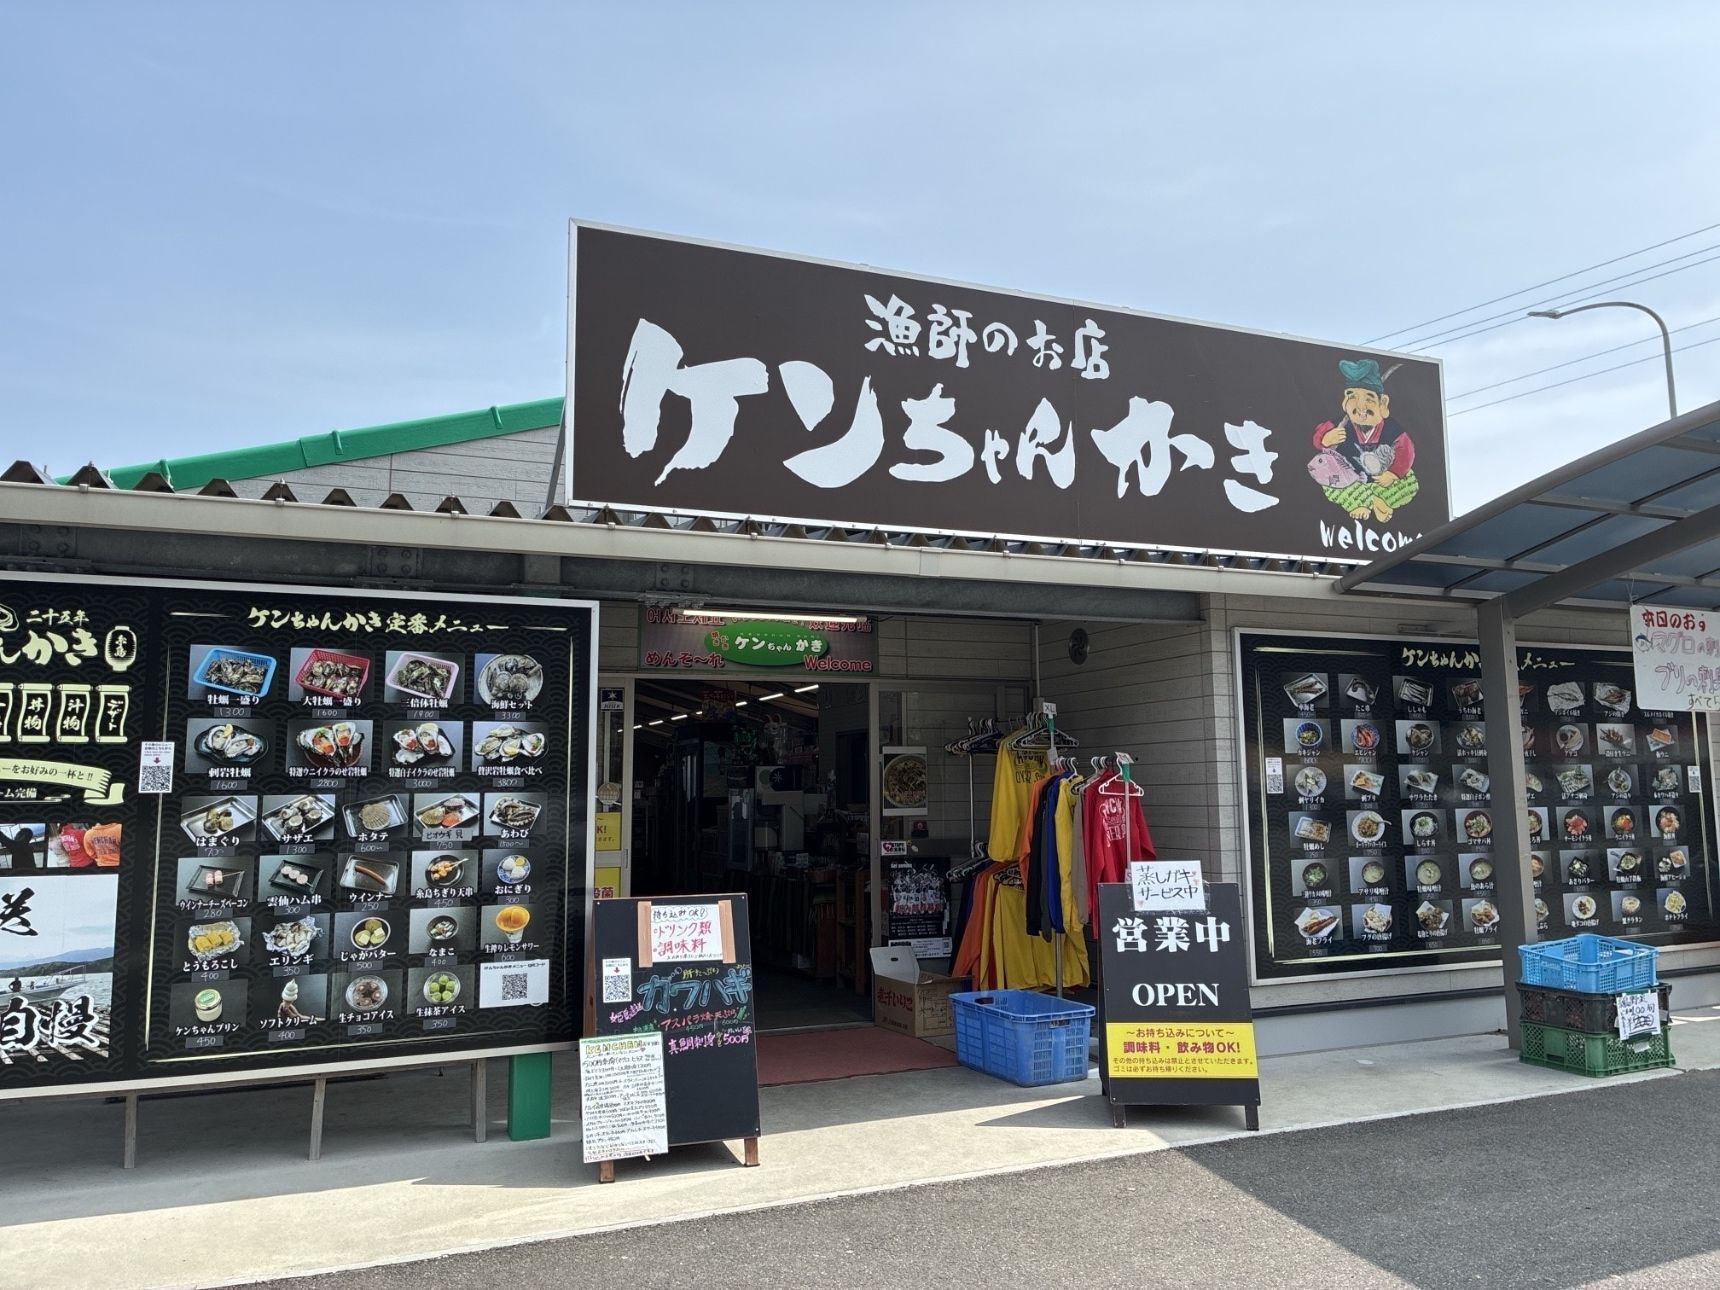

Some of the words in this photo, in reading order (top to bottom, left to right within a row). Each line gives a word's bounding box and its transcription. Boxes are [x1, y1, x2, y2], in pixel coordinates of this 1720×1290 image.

[864, 293, 1109, 380] 漁師のお店
[620, 317, 1281, 514] ケンちゃんかき
[26, 608, 89, 626] 二十五年
[803, 654, 873, 671] Welcome
[207, 695, 260, 706] 牡蠣一盛り
[302, 696, 361, 706] 大牡蠣一盛り
[400, 698, 448, 708] 三倍体牡蠣
[491, 700, 533, 710] 海鮮セット
[62, 697, 85, 731] 汁物
[281, 834, 313, 843] サザエ
[358, 832, 389, 841] ホタテ
[501, 829, 529, 838] あわび
[196, 836, 240, 847] はまぐり
[416, 888, 473, 899] 糸島ちぎり天串
[494, 885, 531, 895] おにぎり
[1138, 887, 1198, 901] サービス中
[267, 894, 322, 907] 雲仙ハム串
[349, 893, 392, 903] ウインナー
[179, 899, 248, 910] ウインナーチーズベーコン
[1112, 916, 1230, 953] 営業中
[428, 948, 455, 957] なまこ
[657, 938, 707, 957] 調味料
[269, 954, 314, 966] エリンギ
[340, 950, 396, 961] じゃがバター
[183, 960, 238, 972] とうもろこし
[1132, 983, 1220, 1007] OPEN
[338, 1010, 394, 1023] 生チョコアイス
[416, 1005, 466, 1018] 生抹茶アイス
[260, 1017, 317, 1029] ソフトクリーム
[175, 1023, 240, 1036] ケンちゃんプリン
[722, 1034, 750, 1045] 500円
